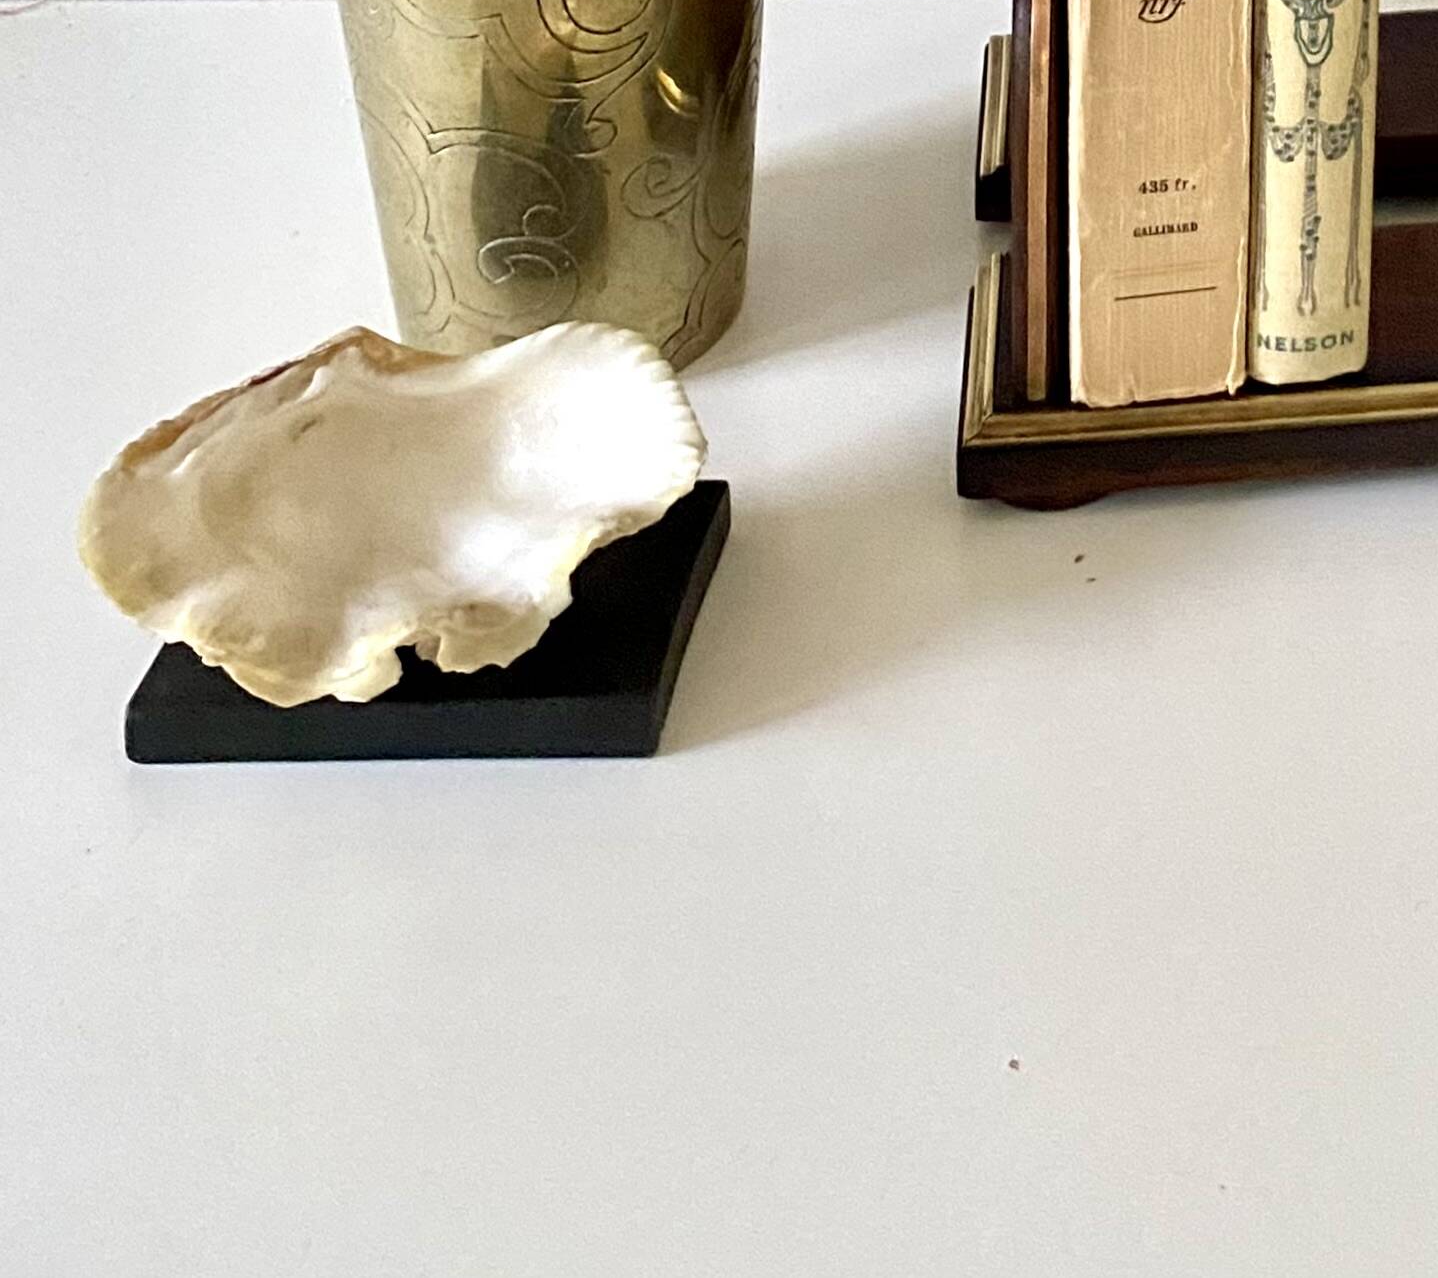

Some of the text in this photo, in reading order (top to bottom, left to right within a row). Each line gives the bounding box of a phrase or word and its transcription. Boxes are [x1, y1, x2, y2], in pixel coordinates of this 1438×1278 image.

[1138, 177, 1197, 195] 435 fr.
[1132, 221, 1199, 238] GALLIMARD
[1256, 329, 1355, 353] NELSON
